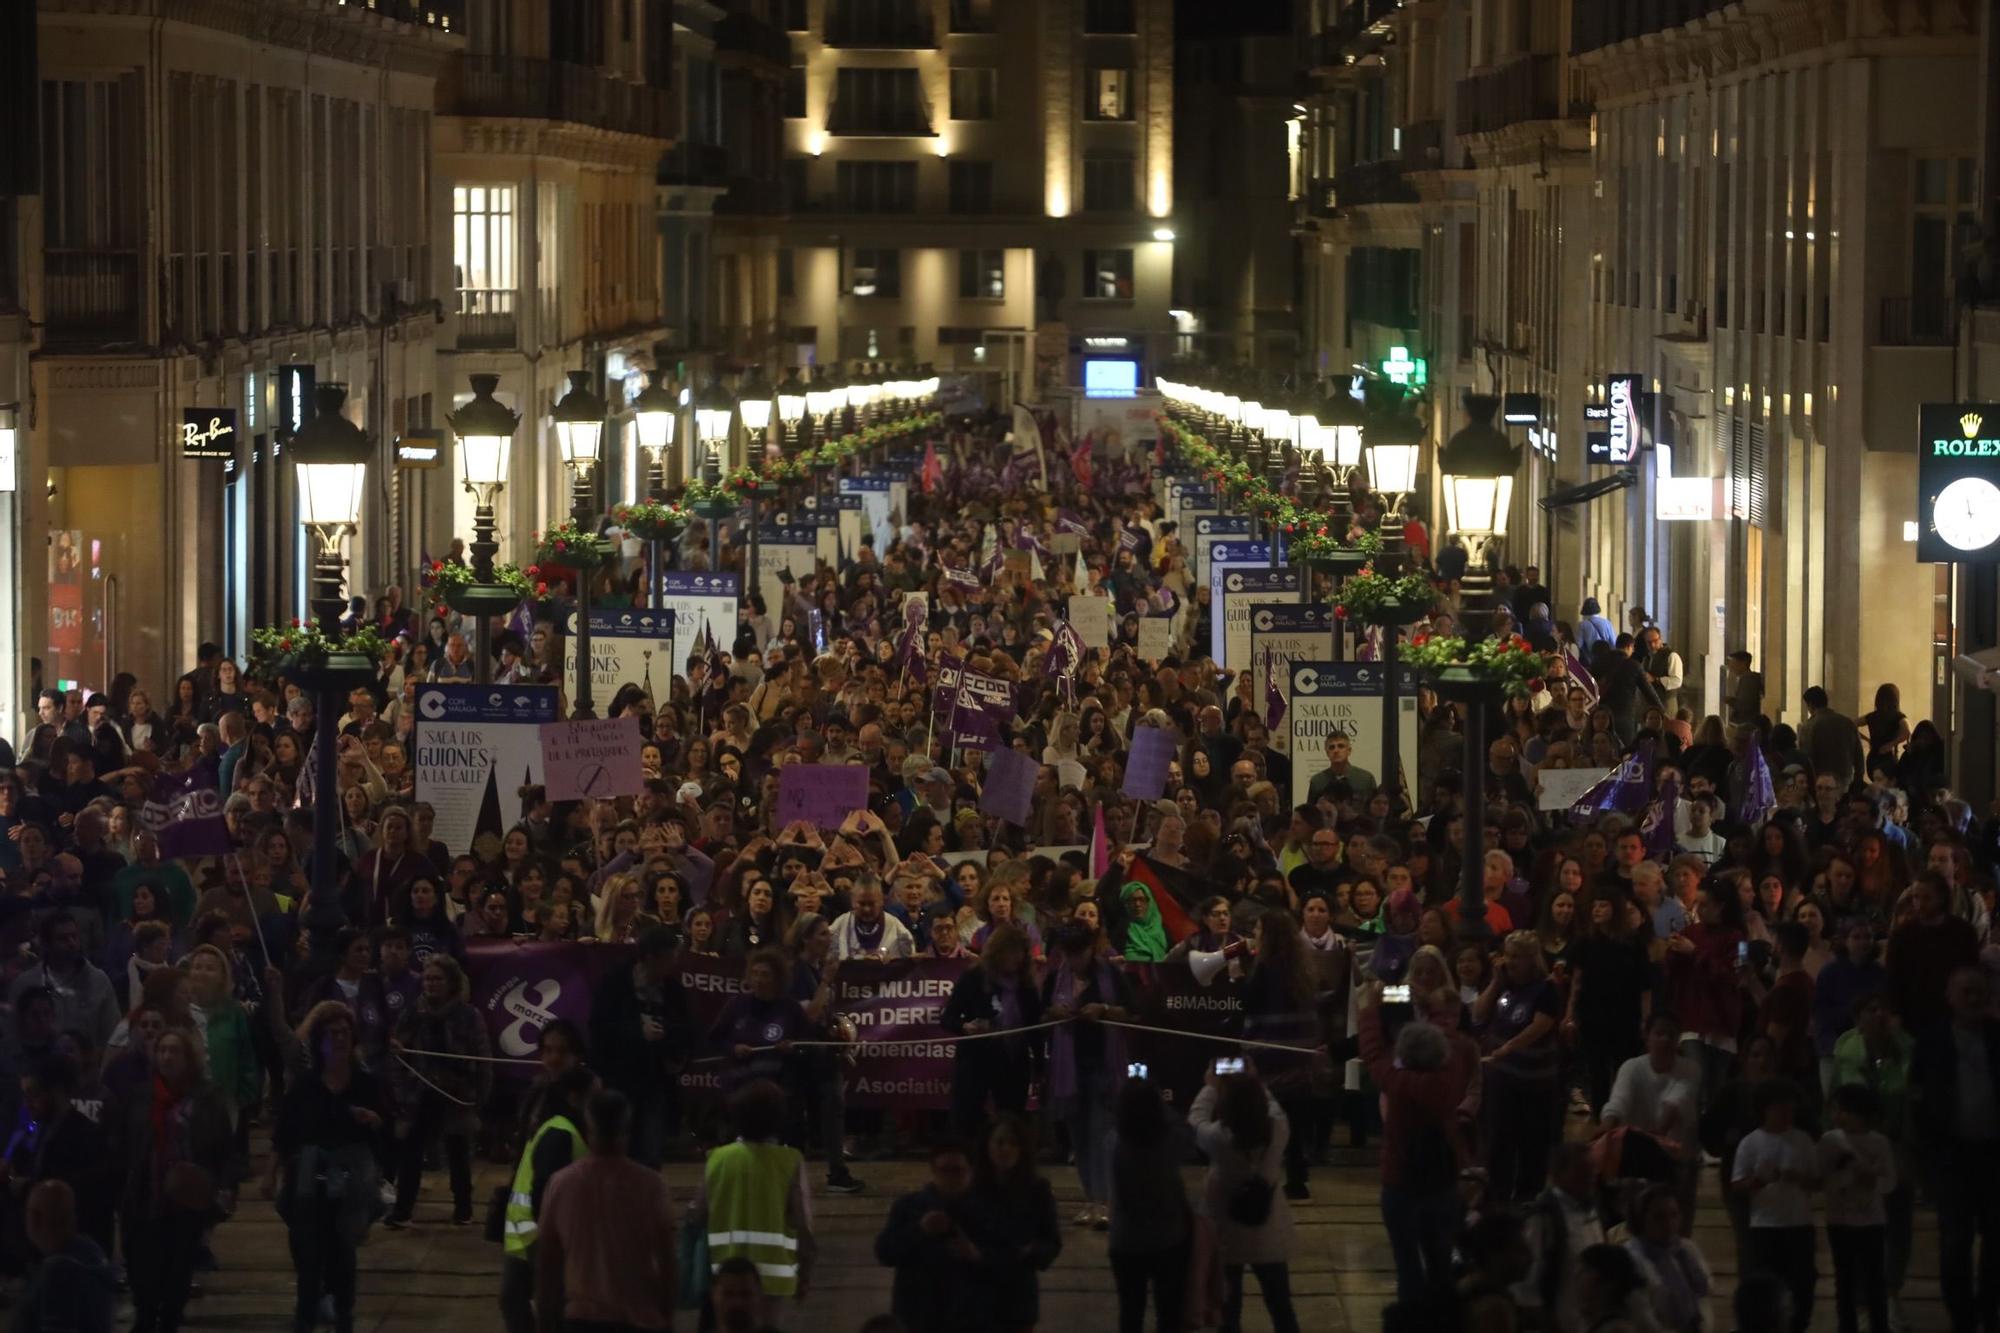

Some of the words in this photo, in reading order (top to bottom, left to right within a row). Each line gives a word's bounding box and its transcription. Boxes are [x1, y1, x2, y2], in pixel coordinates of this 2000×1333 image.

[1610, 380, 1628, 462] PRIMOR
[183, 417, 234, 447] Ray-Ban
[1226, 609, 1250, 622] GUIO
[1333, 703, 1353, 718] LOS
[461, 728, 482, 745] LOS
[1294, 719, 1358, 737] GUIONES
[418, 747, 489, 768] GUIONES
[420, 768, 428, 783] A
[432, 768, 446, 783] LA
[681, 971, 753, 994] DEREC
[841, 981, 873, 998] las
[879, 980, 954, 998] MUJER
[1166, 994, 1244, 1011] #8MAbolic
[880, 1007, 945, 1025] DERE
[855, 1075, 952, 1095] Asociativ
